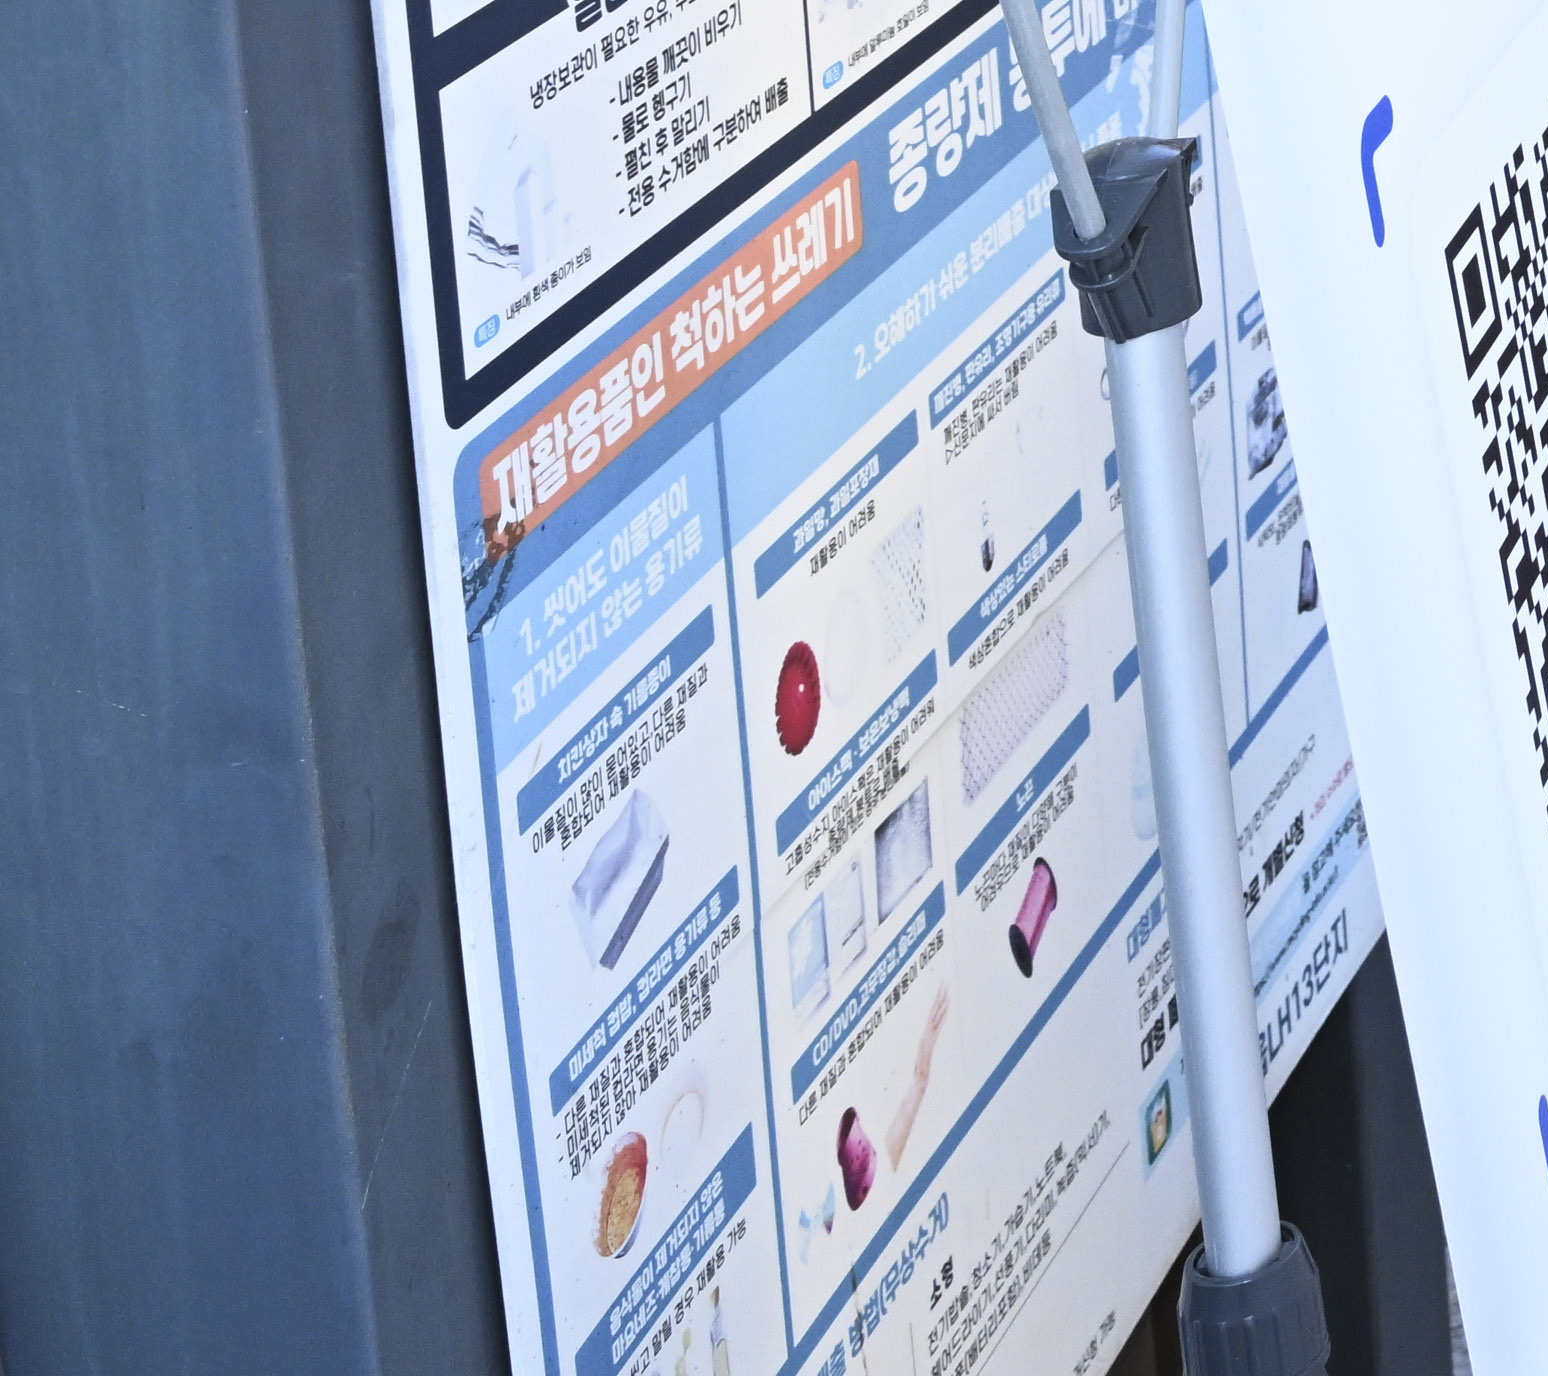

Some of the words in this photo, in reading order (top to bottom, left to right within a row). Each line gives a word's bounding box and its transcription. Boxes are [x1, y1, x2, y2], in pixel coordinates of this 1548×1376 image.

[529, 43, 598, 110] 냉장보관이
[600, 16, 640, 62] 필요한
[618, 56, 659, 106] 내용물
[661, 27, 702, 74] 깨끗이
[703, 0, 742, 47] 비우기
[621, 101, 650, 144] 물로
[651, 71, 692, 122] 헹구기
[888, 48, 1002, 211] 종량제
[624, 137, 652, 181] 펼친
[654, 126, 669, 156] 후
[670, 95, 710, 147] 말리기
[627, 174, 655, 217] 전용
[657, 133, 710, 192] 수거함에
[712, 95, 762, 151] 구분하여
[763, 76, 789, 114] 배출
[493, 333, 665, 531] 재활용품인
[669, 264, 765, 371] 척하는
[771, 178, 854, 303] 쓰레기
[505, 290, 532, 320] 내부에
[575, 245, 592, 269] 보임
[853, 342, 872, 381] 2.
[937, 250, 969, 300] 쉬운
[969, 199, 1025, 273] 분리배출
[511, 611, 598, 722] 제거되지
[600, 577, 642, 638] 않는
[645, 514, 703, 596] 용기류
[518, 618, 541, 656] 1.
[543, 549, 607, 637] 씻어도
[609, 475, 688, 572] 이물질이
[809, 527, 847, 575] 재활용이
[848, 498, 876, 538] 어려움
[531, 792, 578, 854] 이물질이
[579, 766, 603, 806] 많이
[675, 662, 708, 708] 재질과
[557, 716, 609, 783] 치킨상자
[623, 654, 671, 715] 기름종이
[559, 788, 605, 851] 혼합되어
[607, 741, 652, 800] 재활용이
[653, 707, 686, 753] 어려움
[563, 1093, 587, 1135] 다른
[588, 1052, 622, 1105] 재질과
[623, 1000, 666, 1065] 혼합되어
[667, 950, 708, 1010] 재활용이
[710, 913, 741, 960] 어려움
[565, 1088, 612, 1161] 미세척된
[610, 1047, 646, 1106] 컵라면
[646, 1014, 678, 1062] 용기는
[679, 960, 720, 1023] 음식물이
[568, 1022, 607, 1081] 미세척
[606, 992, 637, 1037] 컵밥,
[636, 945, 673, 1003] 컵라면
[673, 905, 709, 960] 용기류
[798, 1089, 818, 1126] 다른
[818, 1053, 846, 1099] 재질과
[847, 1010, 882, 1063] 혼합되어
[883, 964, 917, 1013] 재활용이
[919, 928, 944, 970] 어려움
[568, 1113, 613, 1180] 제거되지
[613, 1084, 637, 1126] 않아
[637, 1032, 680, 1095] 재활용이
[681, 993, 712, 1042] 어려움
[609, 1260, 654, 1336] 음식물이
[654, 1199, 700, 1274] 제거되지
[699, 1170, 723, 1213] 않은
[651, 1315, 673, 1357] 말릴
[673, 1285, 694, 1325] 경우
[695, 1243, 725, 1294] 재활용
[726, 1217, 747, 1253] 가능
[848, 1192, 949, 1357] 방법(무상수거)
[929, 1254, 954, 1310] 소형
